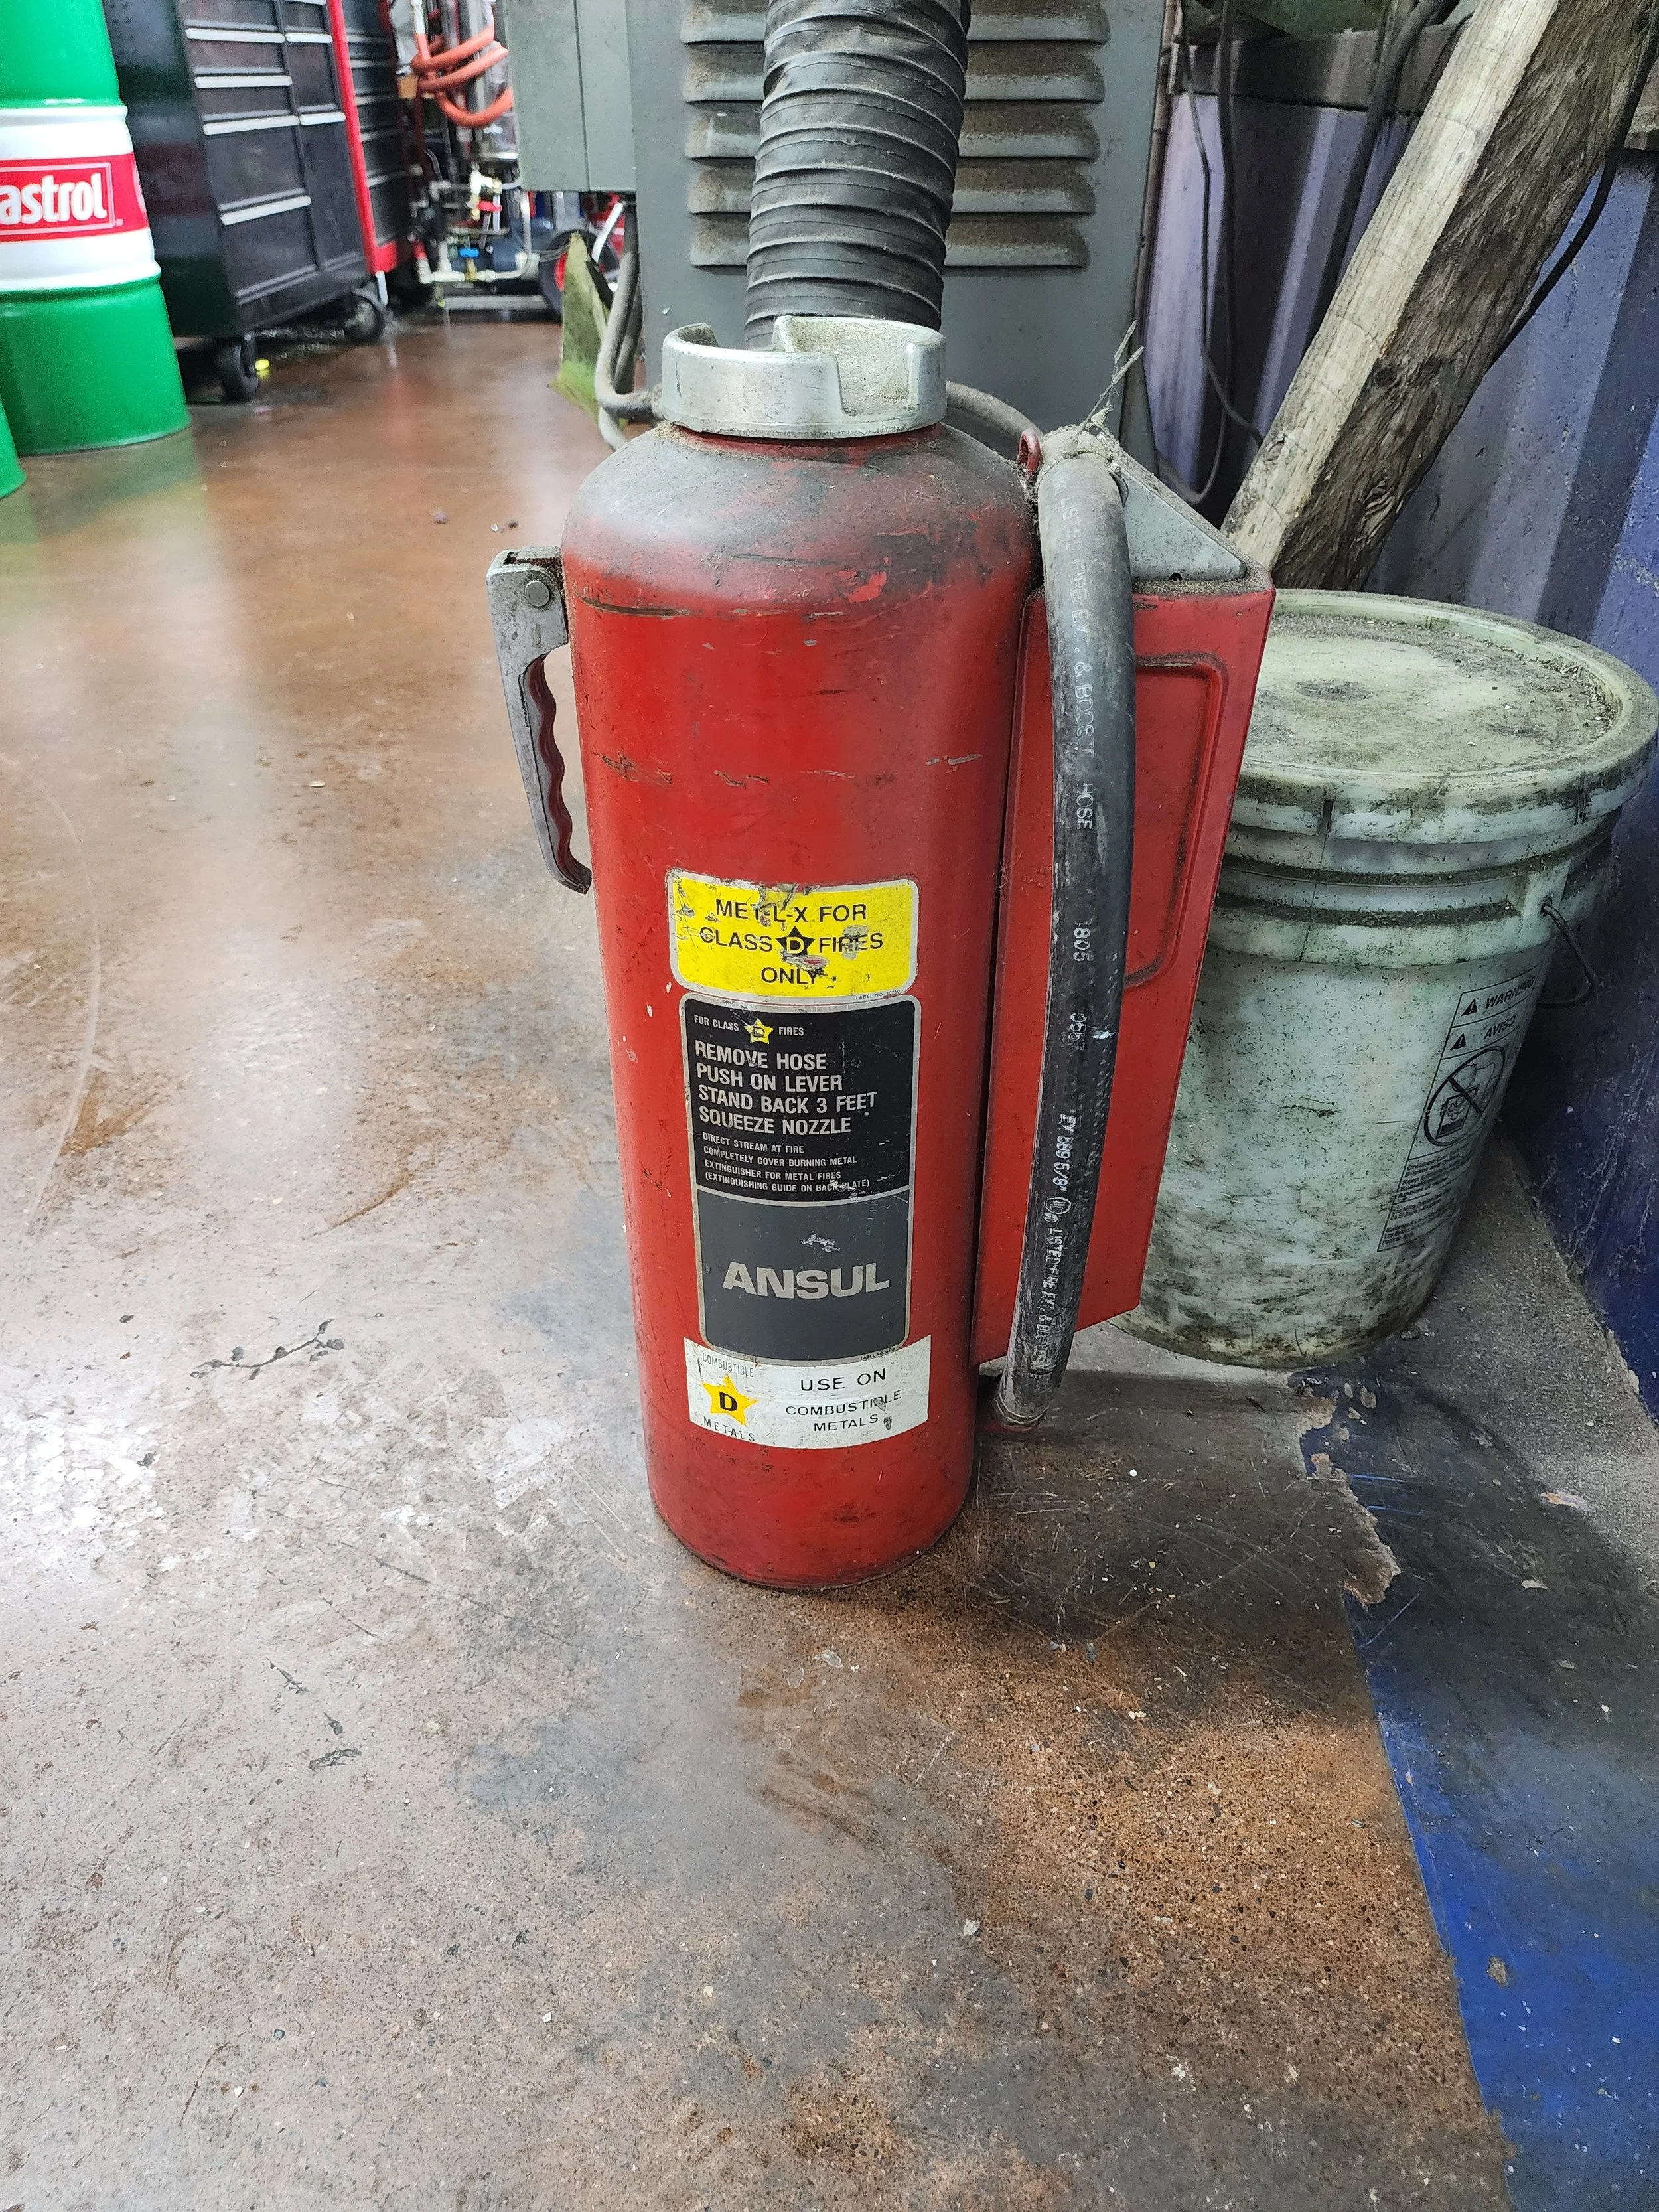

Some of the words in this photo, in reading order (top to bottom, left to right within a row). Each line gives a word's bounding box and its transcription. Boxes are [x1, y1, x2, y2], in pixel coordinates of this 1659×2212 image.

[0, 173, 107, 225] astrol
[1074, 661, 1092, 678] &
[1076, 782, 1094, 830] HOSE
[716, 899, 808, 923] MET-L-X
[820, 904, 867, 922] FOR
[700, 926, 773, 952] CLASS
[786, 936, 805, 954] D
[819, 932, 883, 953] FIRES
[761, 966, 820, 984] ONLY
[1486, 976, 1536, 1009] WARNING
[694, 1015, 709, 1026] FOR
[713, 1019, 739, 1031] CLASS
[778, 1027, 804, 1036] FIRES
[1484, 1015, 1516, 1040] AVISO
[695, 1040, 768, 1069] REMOVE
[776, 1053, 827, 1070] HOSE
[697, 1062, 743, 1088] PUSH
[751, 1074, 776, 1091] ON
[785, 1075, 843, 1092] LEVER
[698, 1084, 753, 1110] STAND
[761, 1096, 809, 1114] BACK
[816, 1098, 828, 1114] 3
[836, 1091, 878, 1112] FEET
[699, 1106, 774, 1134] SQUEEZE
[782, 1117, 851, 1135] NOZZLE
[703, 1132, 730, 1145] DIRECT
[733, 1140, 768, 1151] STREAM
[771, 1143, 782, 1153] AT
[703, 1145, 753, 1163] COMPLETELY
[757, 1157, 784, 1166] COVER
[830, 1156, 857, 1166] METAL
[705, 1159, 761, 1178] EXTINGUISHER
[818, 1171, 841, 1180] FIRES
[705, 1171, 768, 1190] (EXTINGUISHING
[772, 1183, 798, 1192] GUIDE
[1052, 1162, 1070, 1192] 5/8"
[722, 1262, 890, 1299] ANSUL
[703, 1352, 754, 1378] COMBUSTIBLE
[800, 1377, 845, 1392] USE
[857, 1368, 886, 1386] ON
[719, 1391, 737, 1411] D
[704, 1416, 755, 1441] METALS
[814, 1414, 879, 1432] METALS
